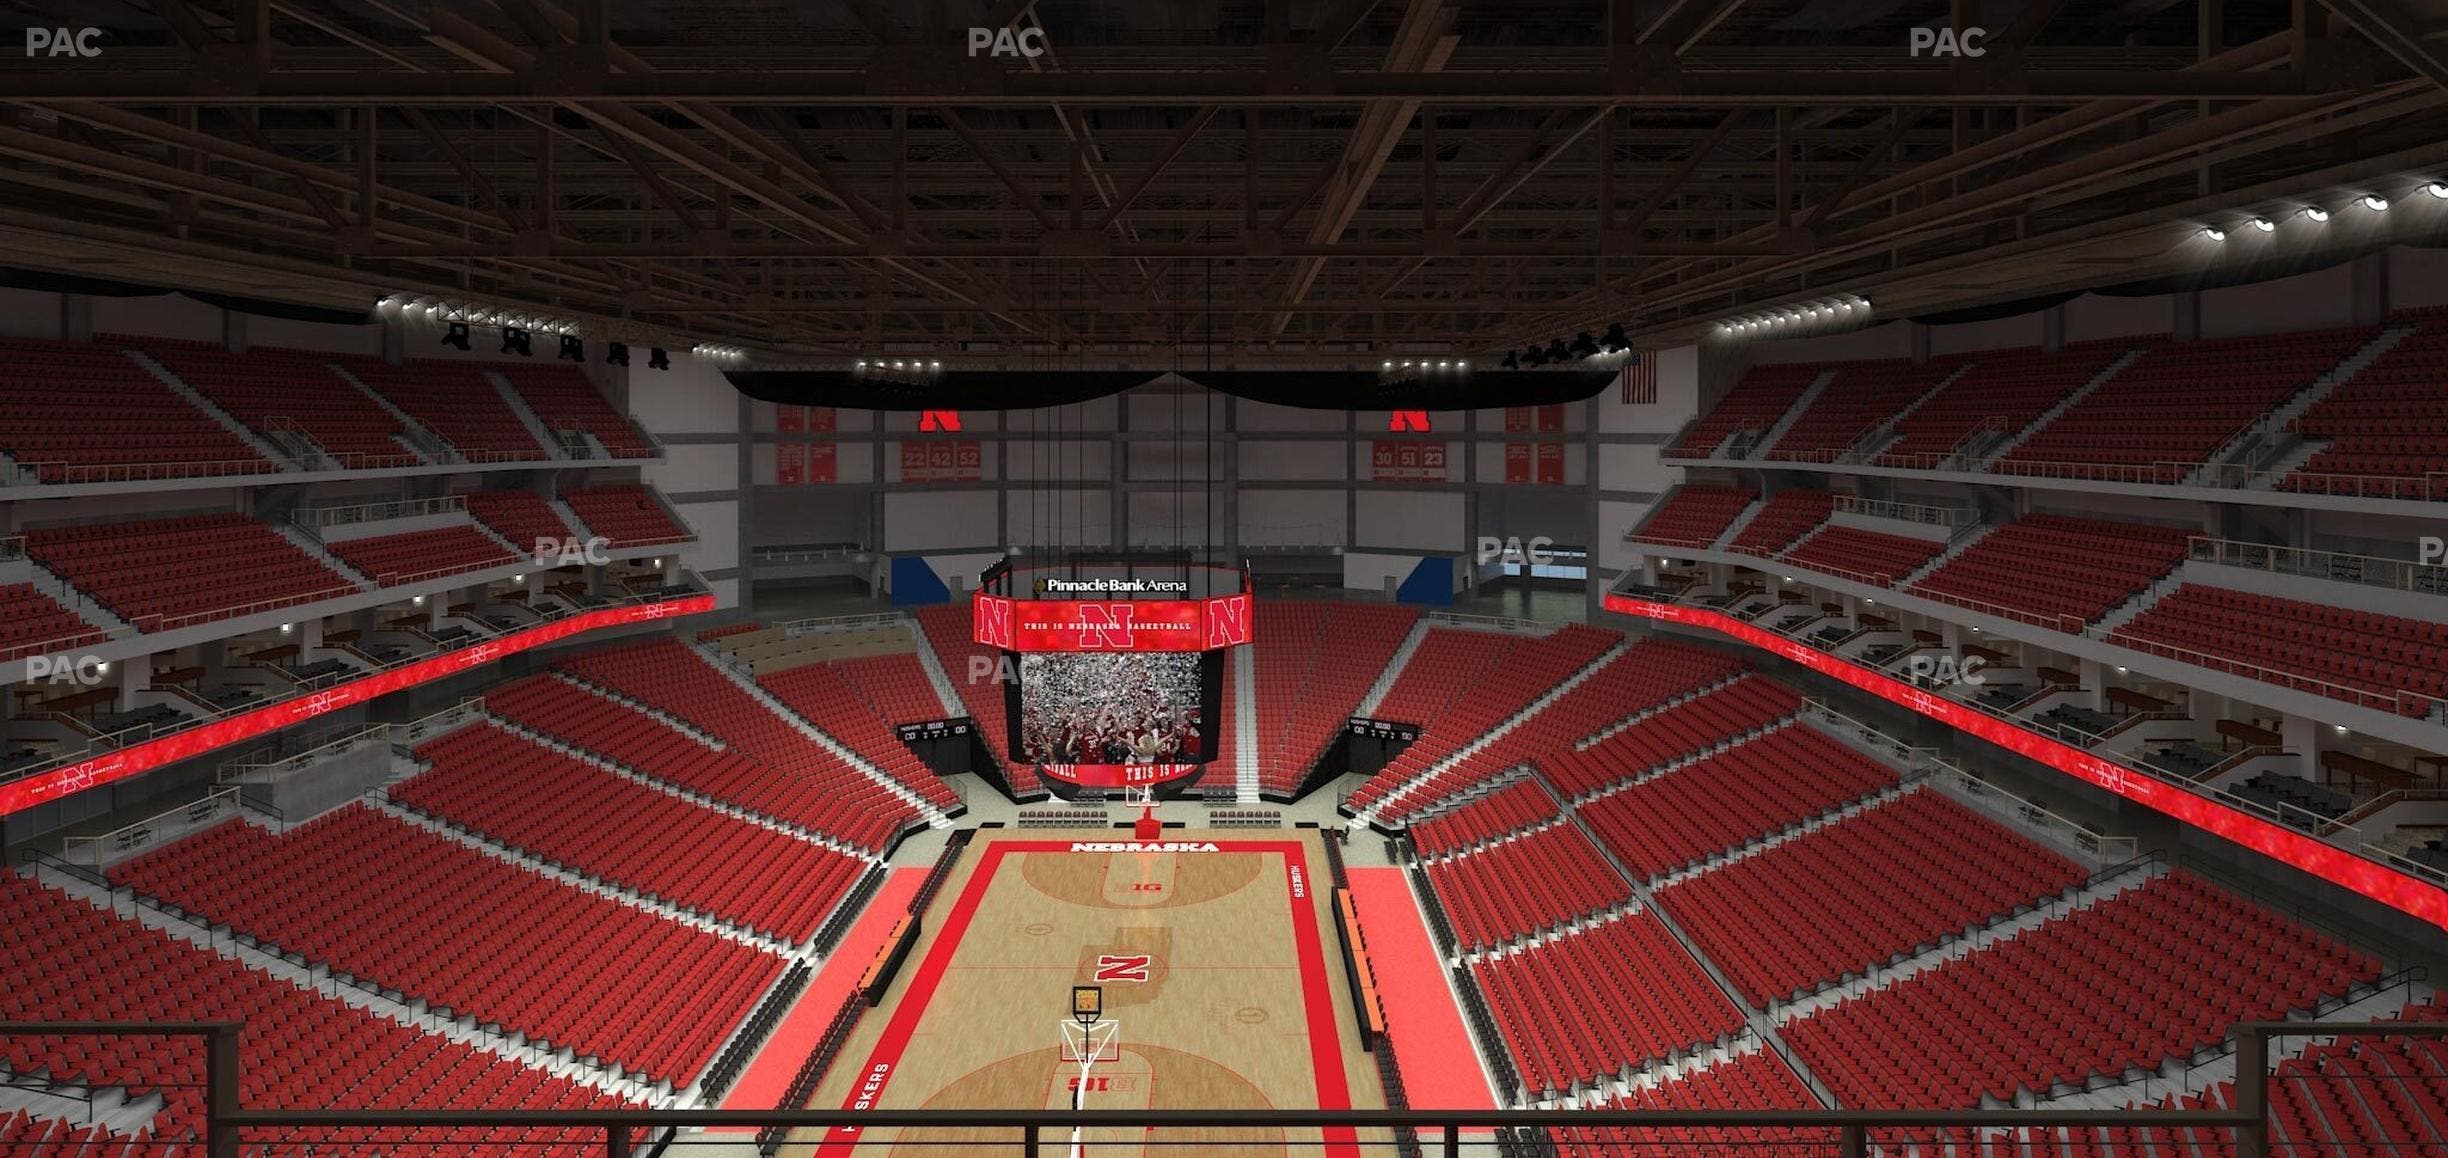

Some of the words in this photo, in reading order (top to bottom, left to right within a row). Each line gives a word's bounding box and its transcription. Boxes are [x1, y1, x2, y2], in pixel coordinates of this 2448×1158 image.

[905, 452, 925, 466] 22
[931, 452, 952, 466] 42
[959, 451, 979, 466] 52
[1376, 452, 1392, 466] 30
[1401, 451, 1417, 466] 51
[1424, 452, 1443, 466] 23
[1048, 578, 1108, 592] Pinnacle
[1109, 578, 1145, 592] Bank
[1146, 579, 1187, 592] Arena
[980, 596, 1008, 648] N
[1024, 622, 1048, 631] THIS
[1053, 622, 1063, 631] IS
[1079, 604, 1133, 648] N
[1209, 596, 1245, 648] N
[1125, 766, 1154, 781] THIS
[1159, 763, 1170, 777] IS
[1071, 842, 1220, 853] NEBRASKA
[1290, 865, 1305, 898] HUSKERS
[1094, 955, 1151, 982] N
